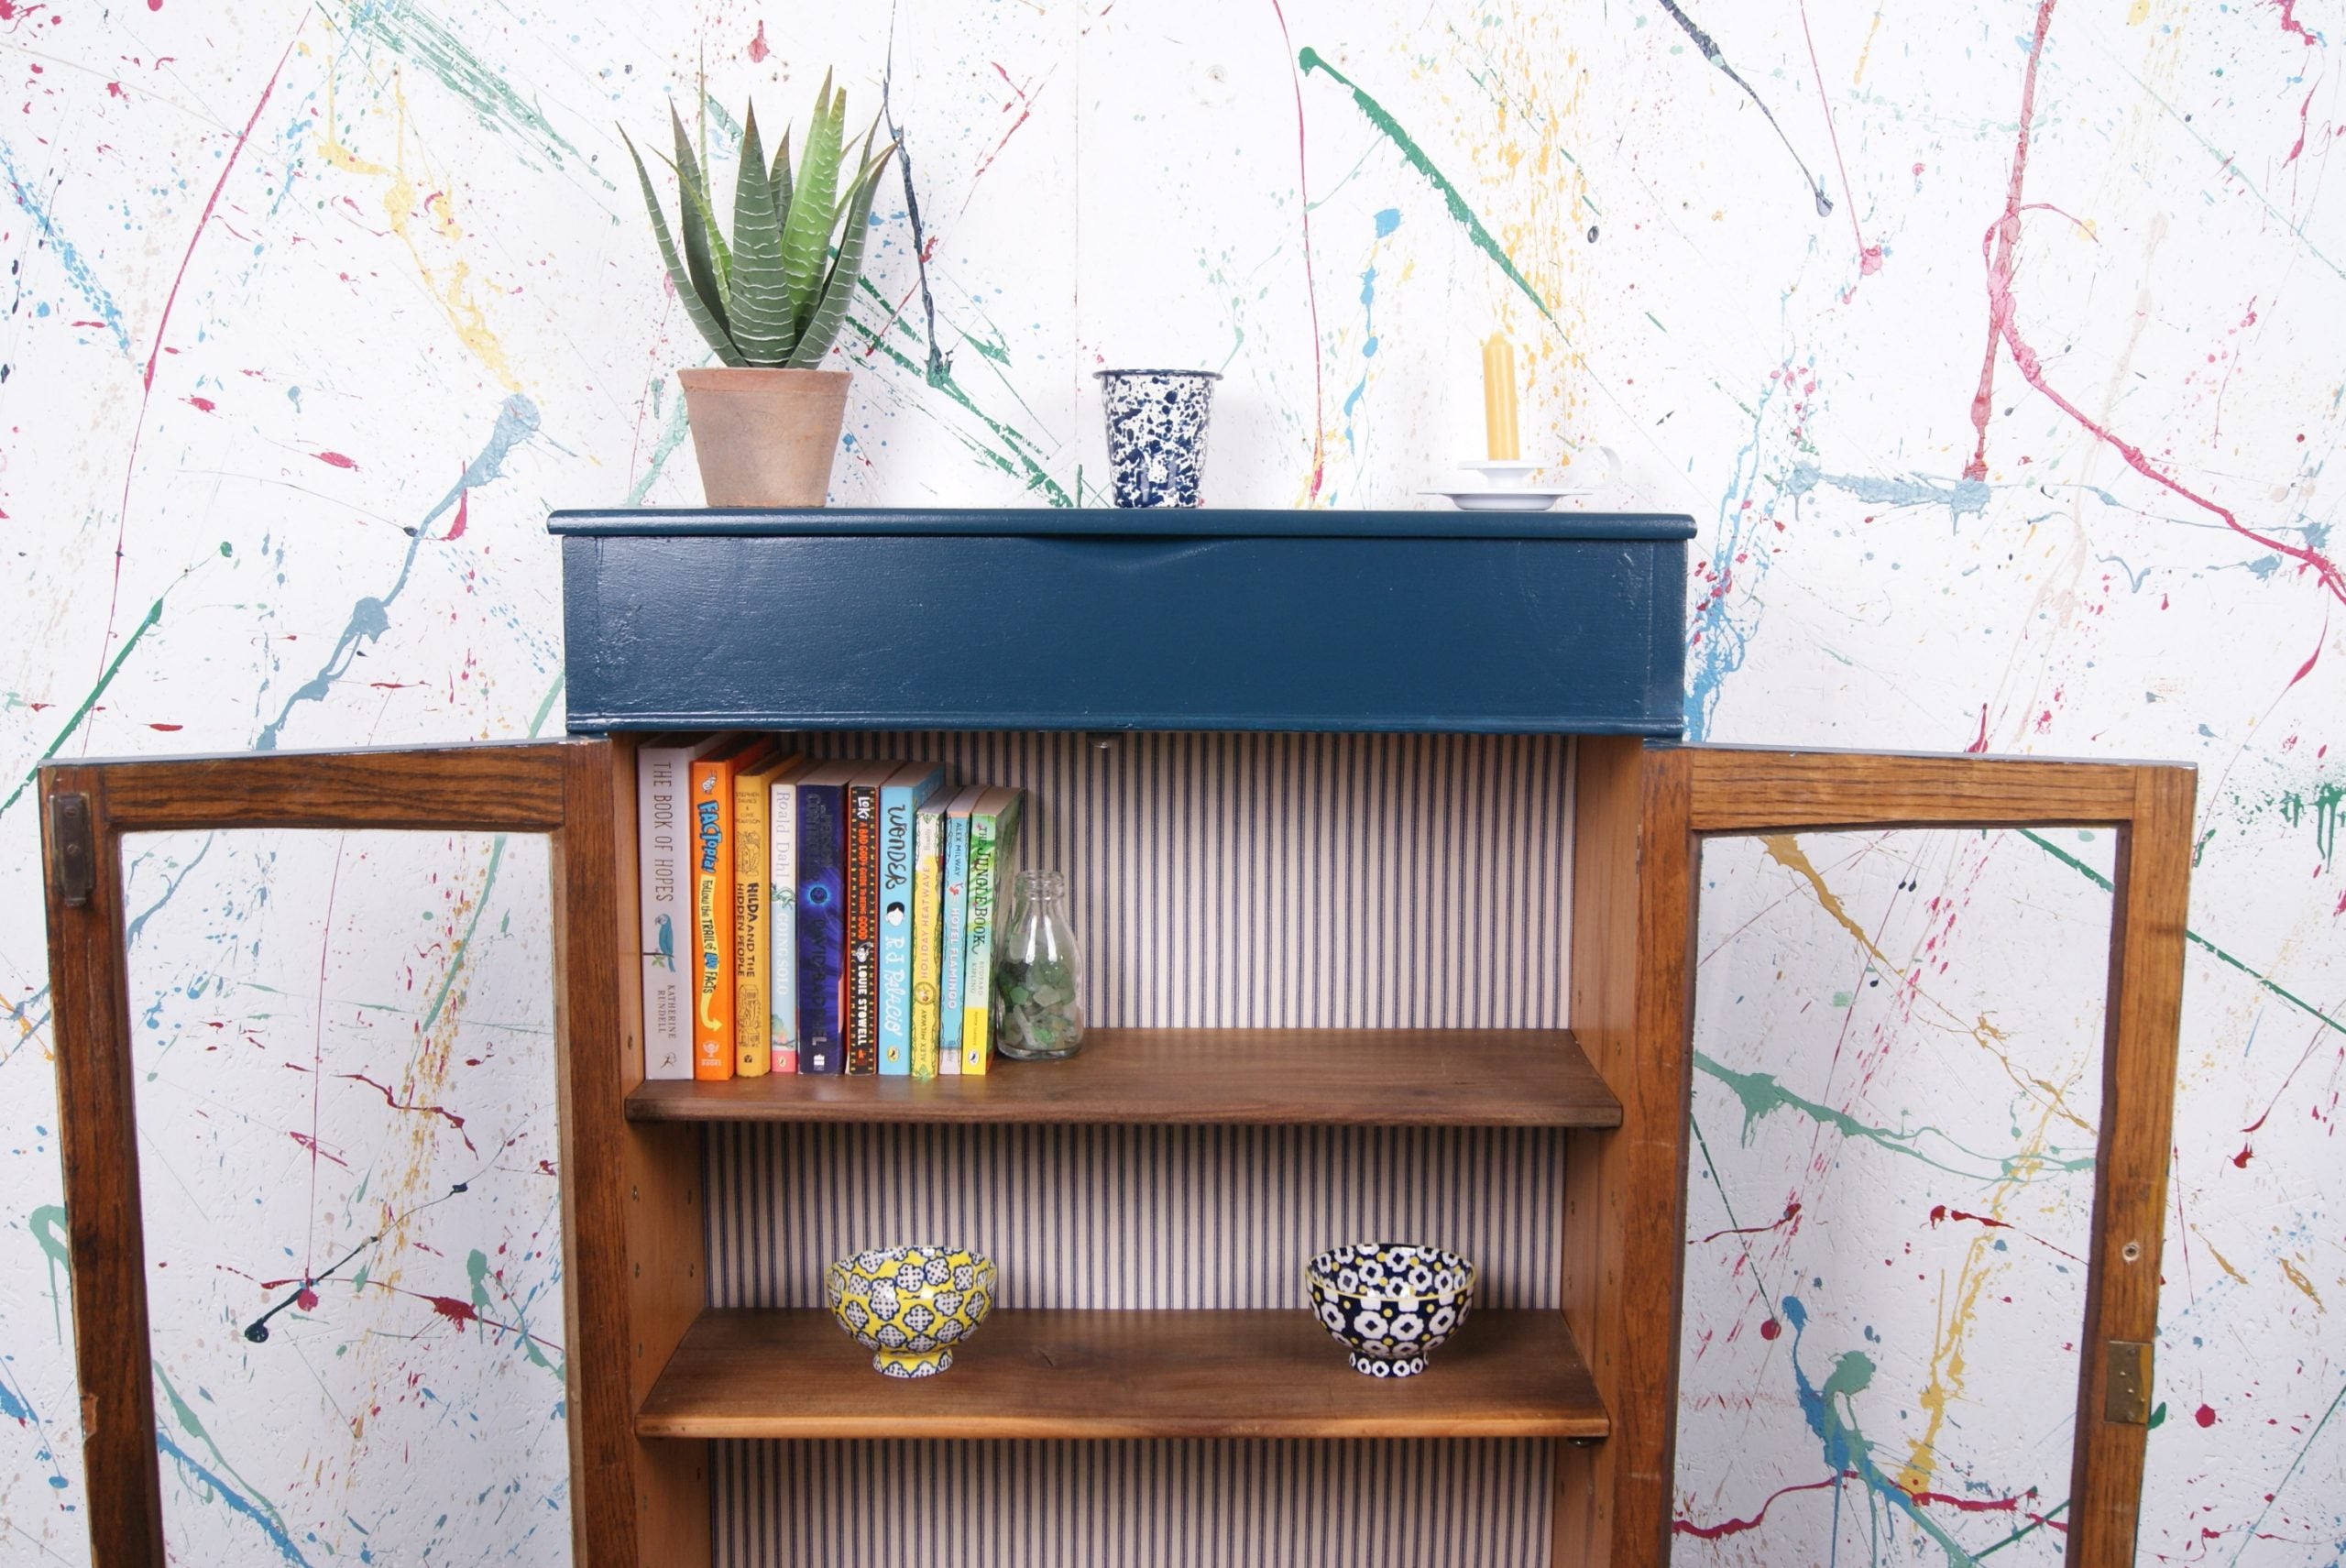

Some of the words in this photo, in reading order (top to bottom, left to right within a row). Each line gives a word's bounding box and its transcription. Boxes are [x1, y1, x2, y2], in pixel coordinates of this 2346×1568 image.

[653, 762, 672, 787] THE
[653, 795, 674, 828] BOOK
[776, 792, 791, 833] Roald
[654, 836, 674, 851] OF
[859, 828, 869, 844] BAD
[978, 827, 987, 845] THE
[776, 842, 790, 877] Dahl
[974, 847, 991, 905] JUNGLE
[654, 859, 674, 902] HOPES
[921, 867, 930, 926] HEATWAVE
[737, 883, 745, 931] HIDDEN
[746, 883, 759, 922] HILDA
[702, 919, 716, 943] TRAIL
[746, 924, 755, 952] AND
[777, 913, 788, 958] GOING
[858, 916, 869, 940] GOOD
[949, 908, 960, 946] HOTEL
[971, 907, 988, 948] BOOK
[737, 935, 745, 976] PEOPLE
[746, 955, 755, 978] THE
[920, 930, 929, 979] HOLIDAY
[777, 959, 788, 995] SOLO
[858, 965, 867, 995] LOUIE
[948, 948, 958, 1010] FLAMINGO
[977, 961, 985, 996] RUDYARD
[657, 990, 666, 1034] RUNDELL
[667, 984, 676, 1038] KATHERINE
[858, 999, 867, 1046] STOWELL
